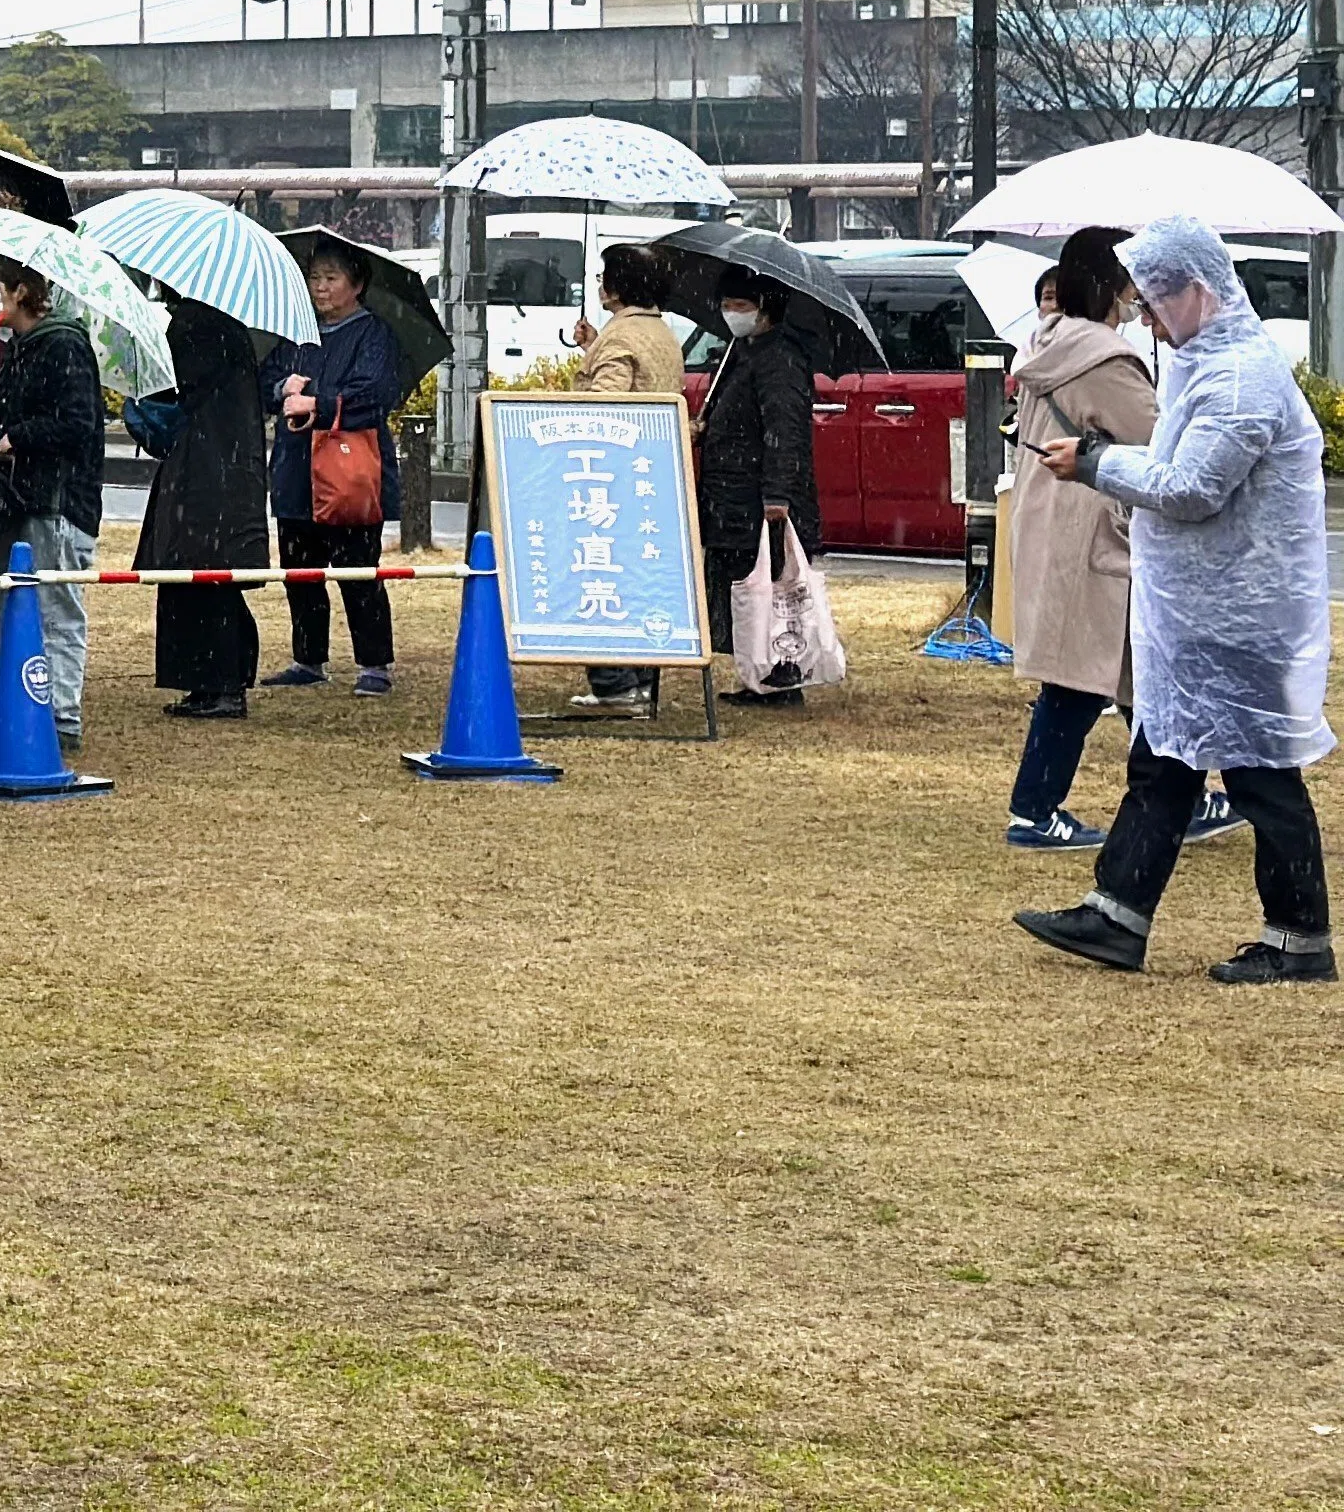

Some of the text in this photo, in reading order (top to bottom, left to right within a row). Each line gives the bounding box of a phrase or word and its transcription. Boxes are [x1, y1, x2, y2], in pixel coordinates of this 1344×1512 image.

[539, 422, 630, 439] 阪本鶏卵
[562, 449, 629, 620] 工場直売
[632, 456, 661, 560] 倉敷・水島
